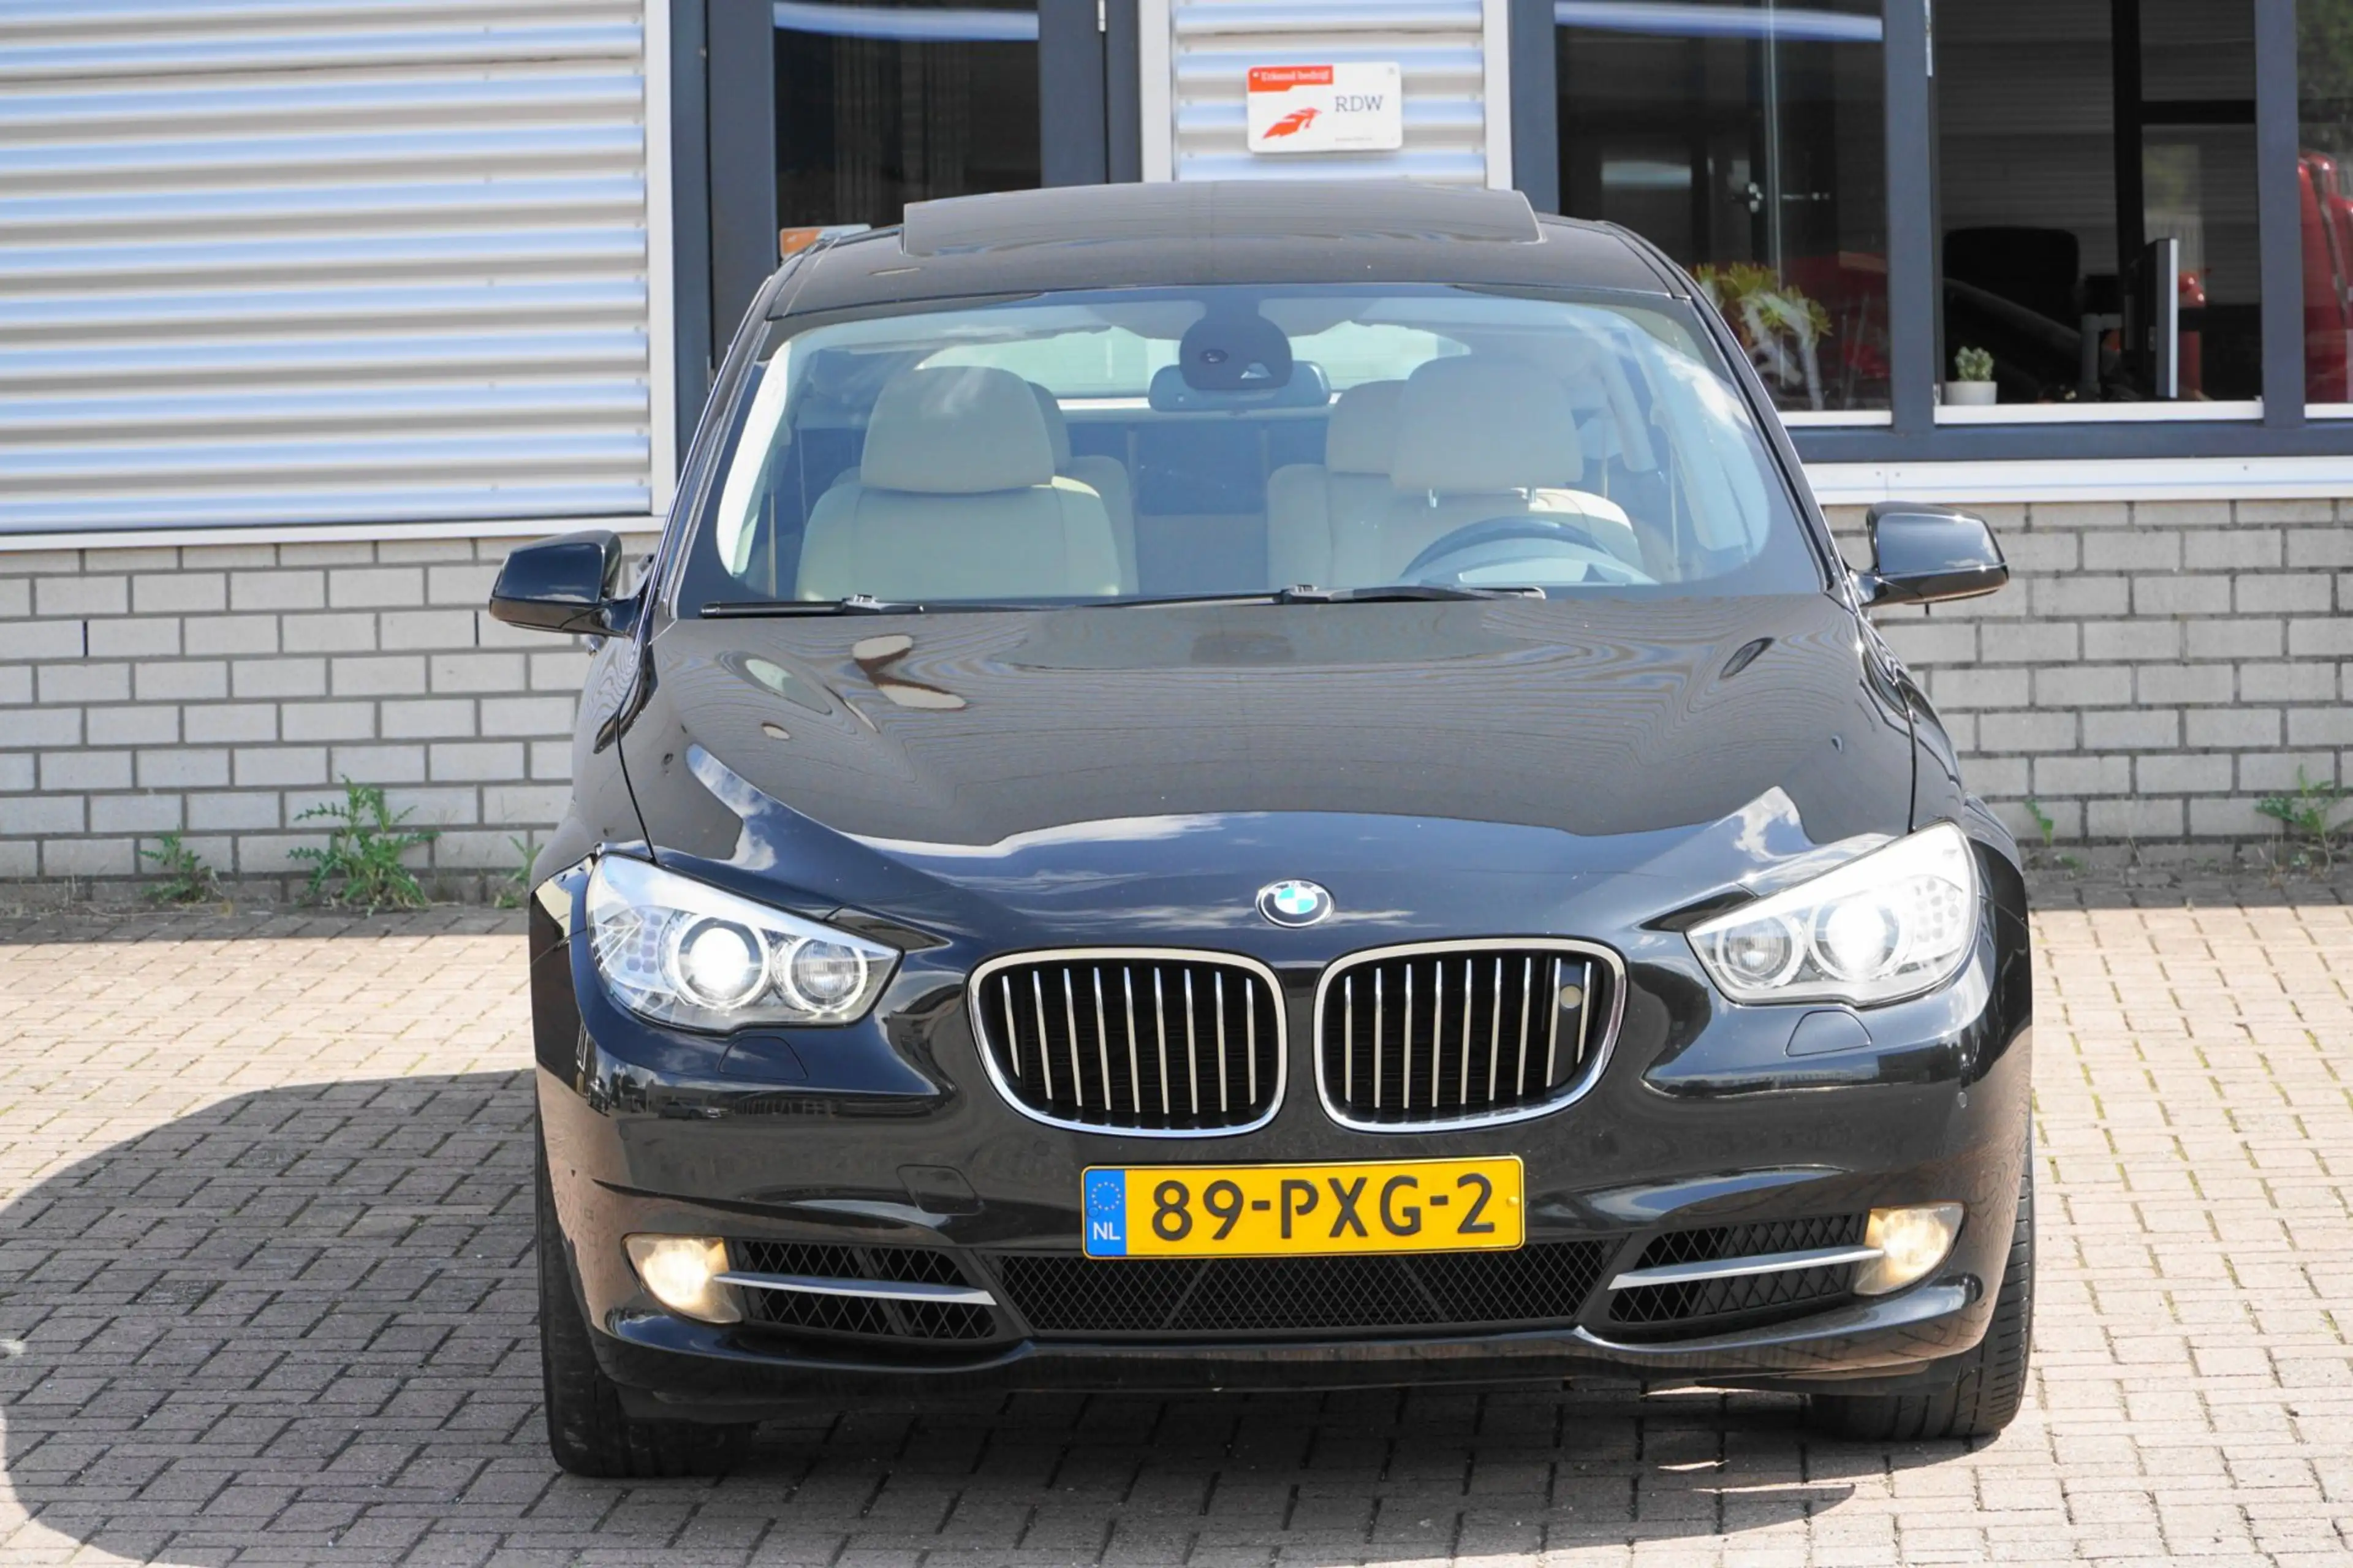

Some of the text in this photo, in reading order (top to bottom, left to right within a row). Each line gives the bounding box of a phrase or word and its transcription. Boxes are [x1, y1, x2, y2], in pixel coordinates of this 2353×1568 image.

[1335, 94, 1384, 112] RDW
[1151, 1173, 1496, 1241] 89-PXG-2
[1093, 1221, 1121, 1240] NL
